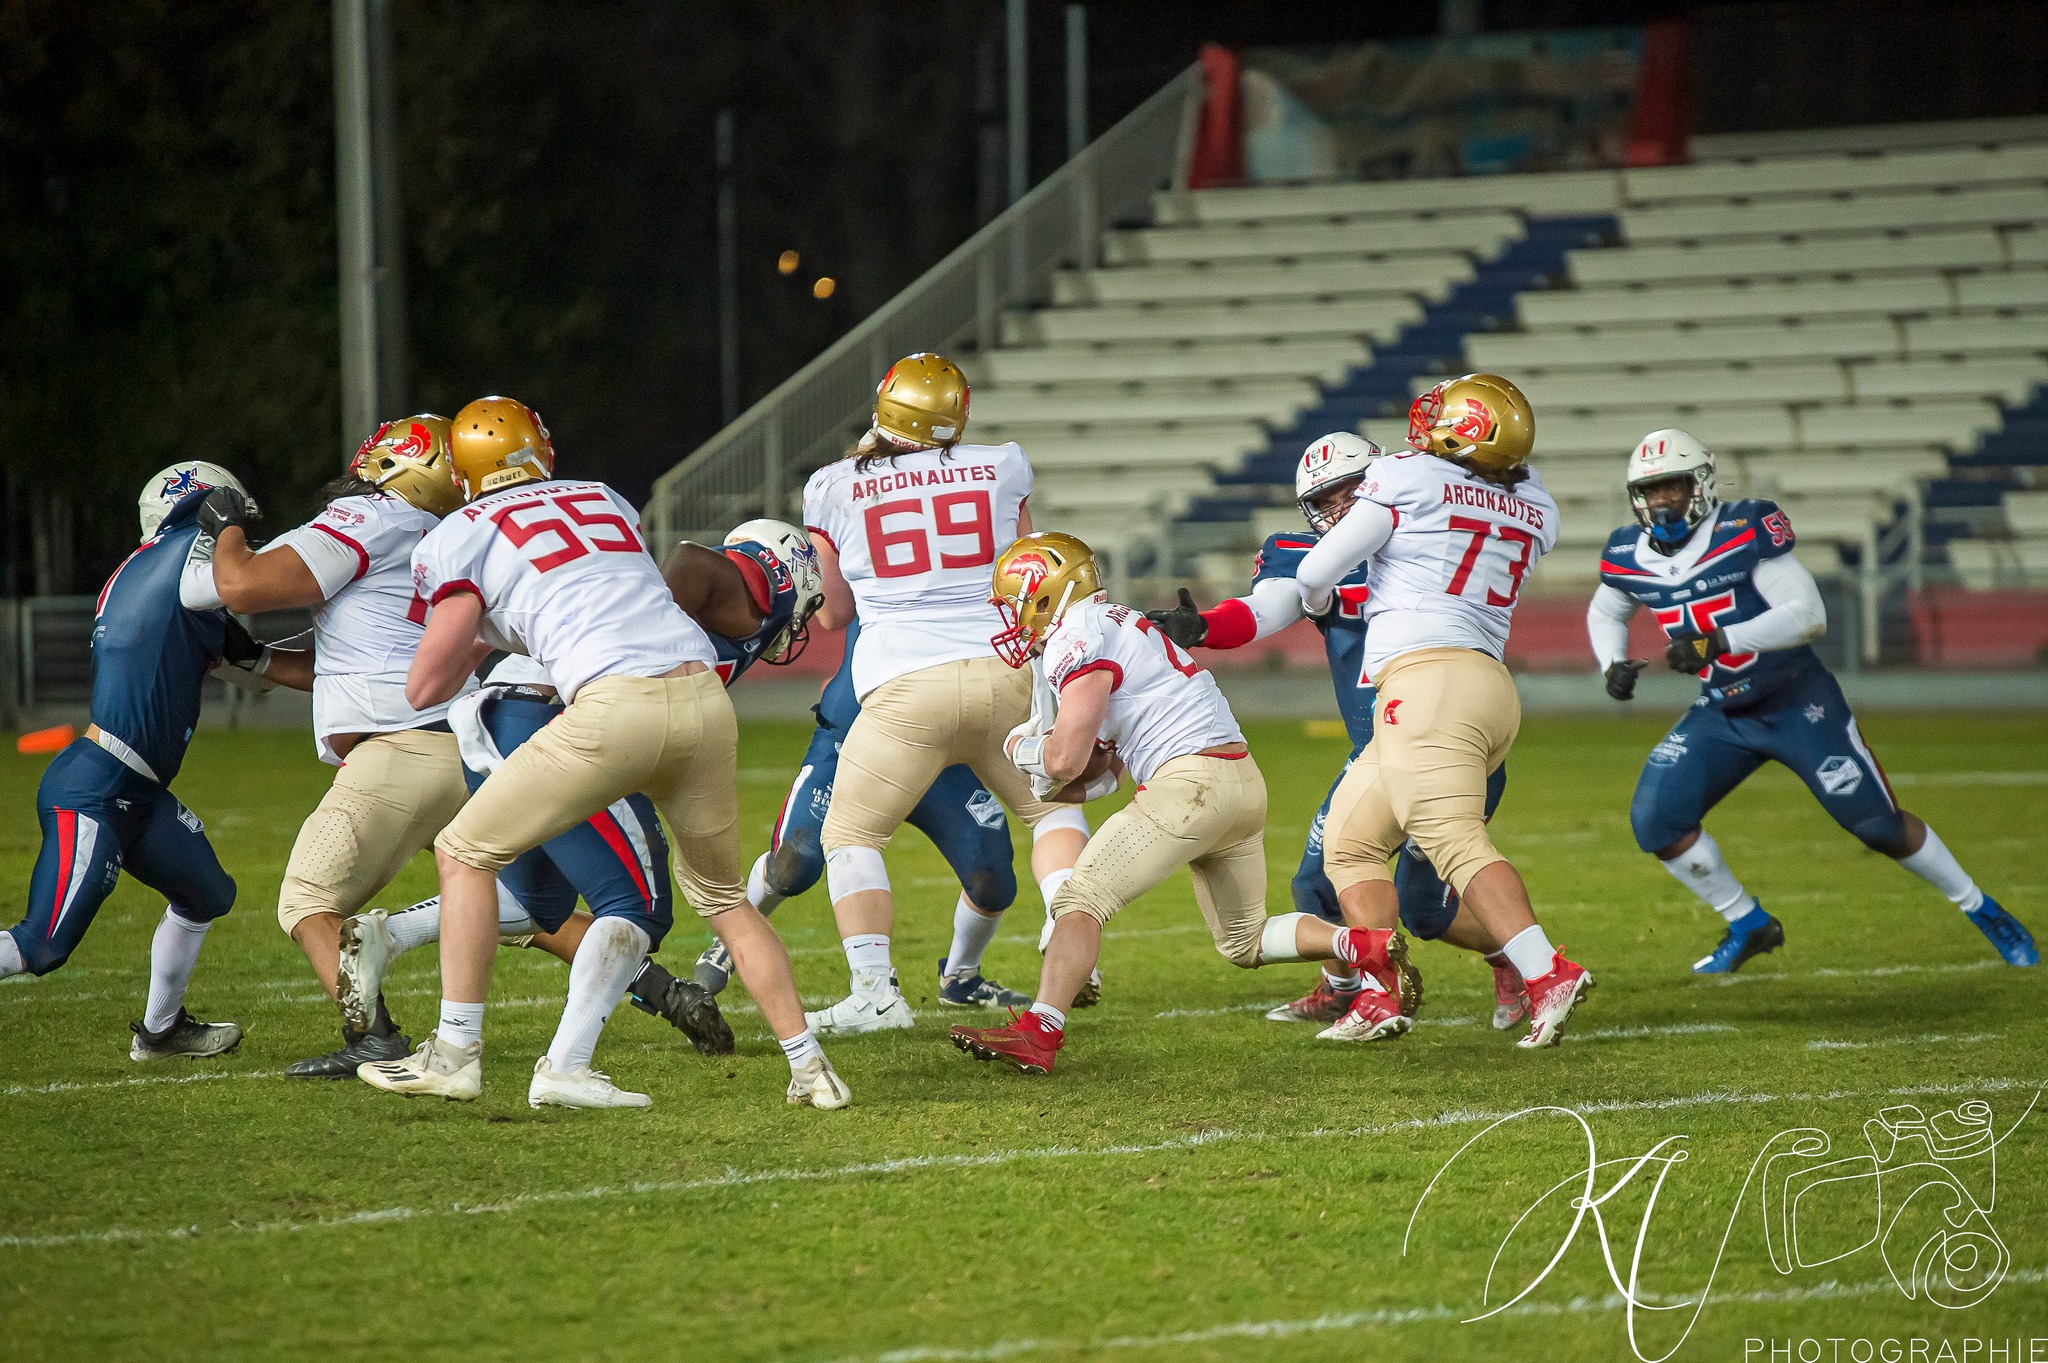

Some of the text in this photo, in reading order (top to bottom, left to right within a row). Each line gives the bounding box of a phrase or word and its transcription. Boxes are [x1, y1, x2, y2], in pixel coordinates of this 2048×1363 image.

[852, 465, 997, 501] ARGONAUTES
[1442, 483, 1544, 530] ARGONAUTES
[489, 492, 643, 574] 55
[864, 490, 995, 578] 69
[1446, 515, 1534, 607] 73
[1054, 652, 1073, 677] BOUCHES
